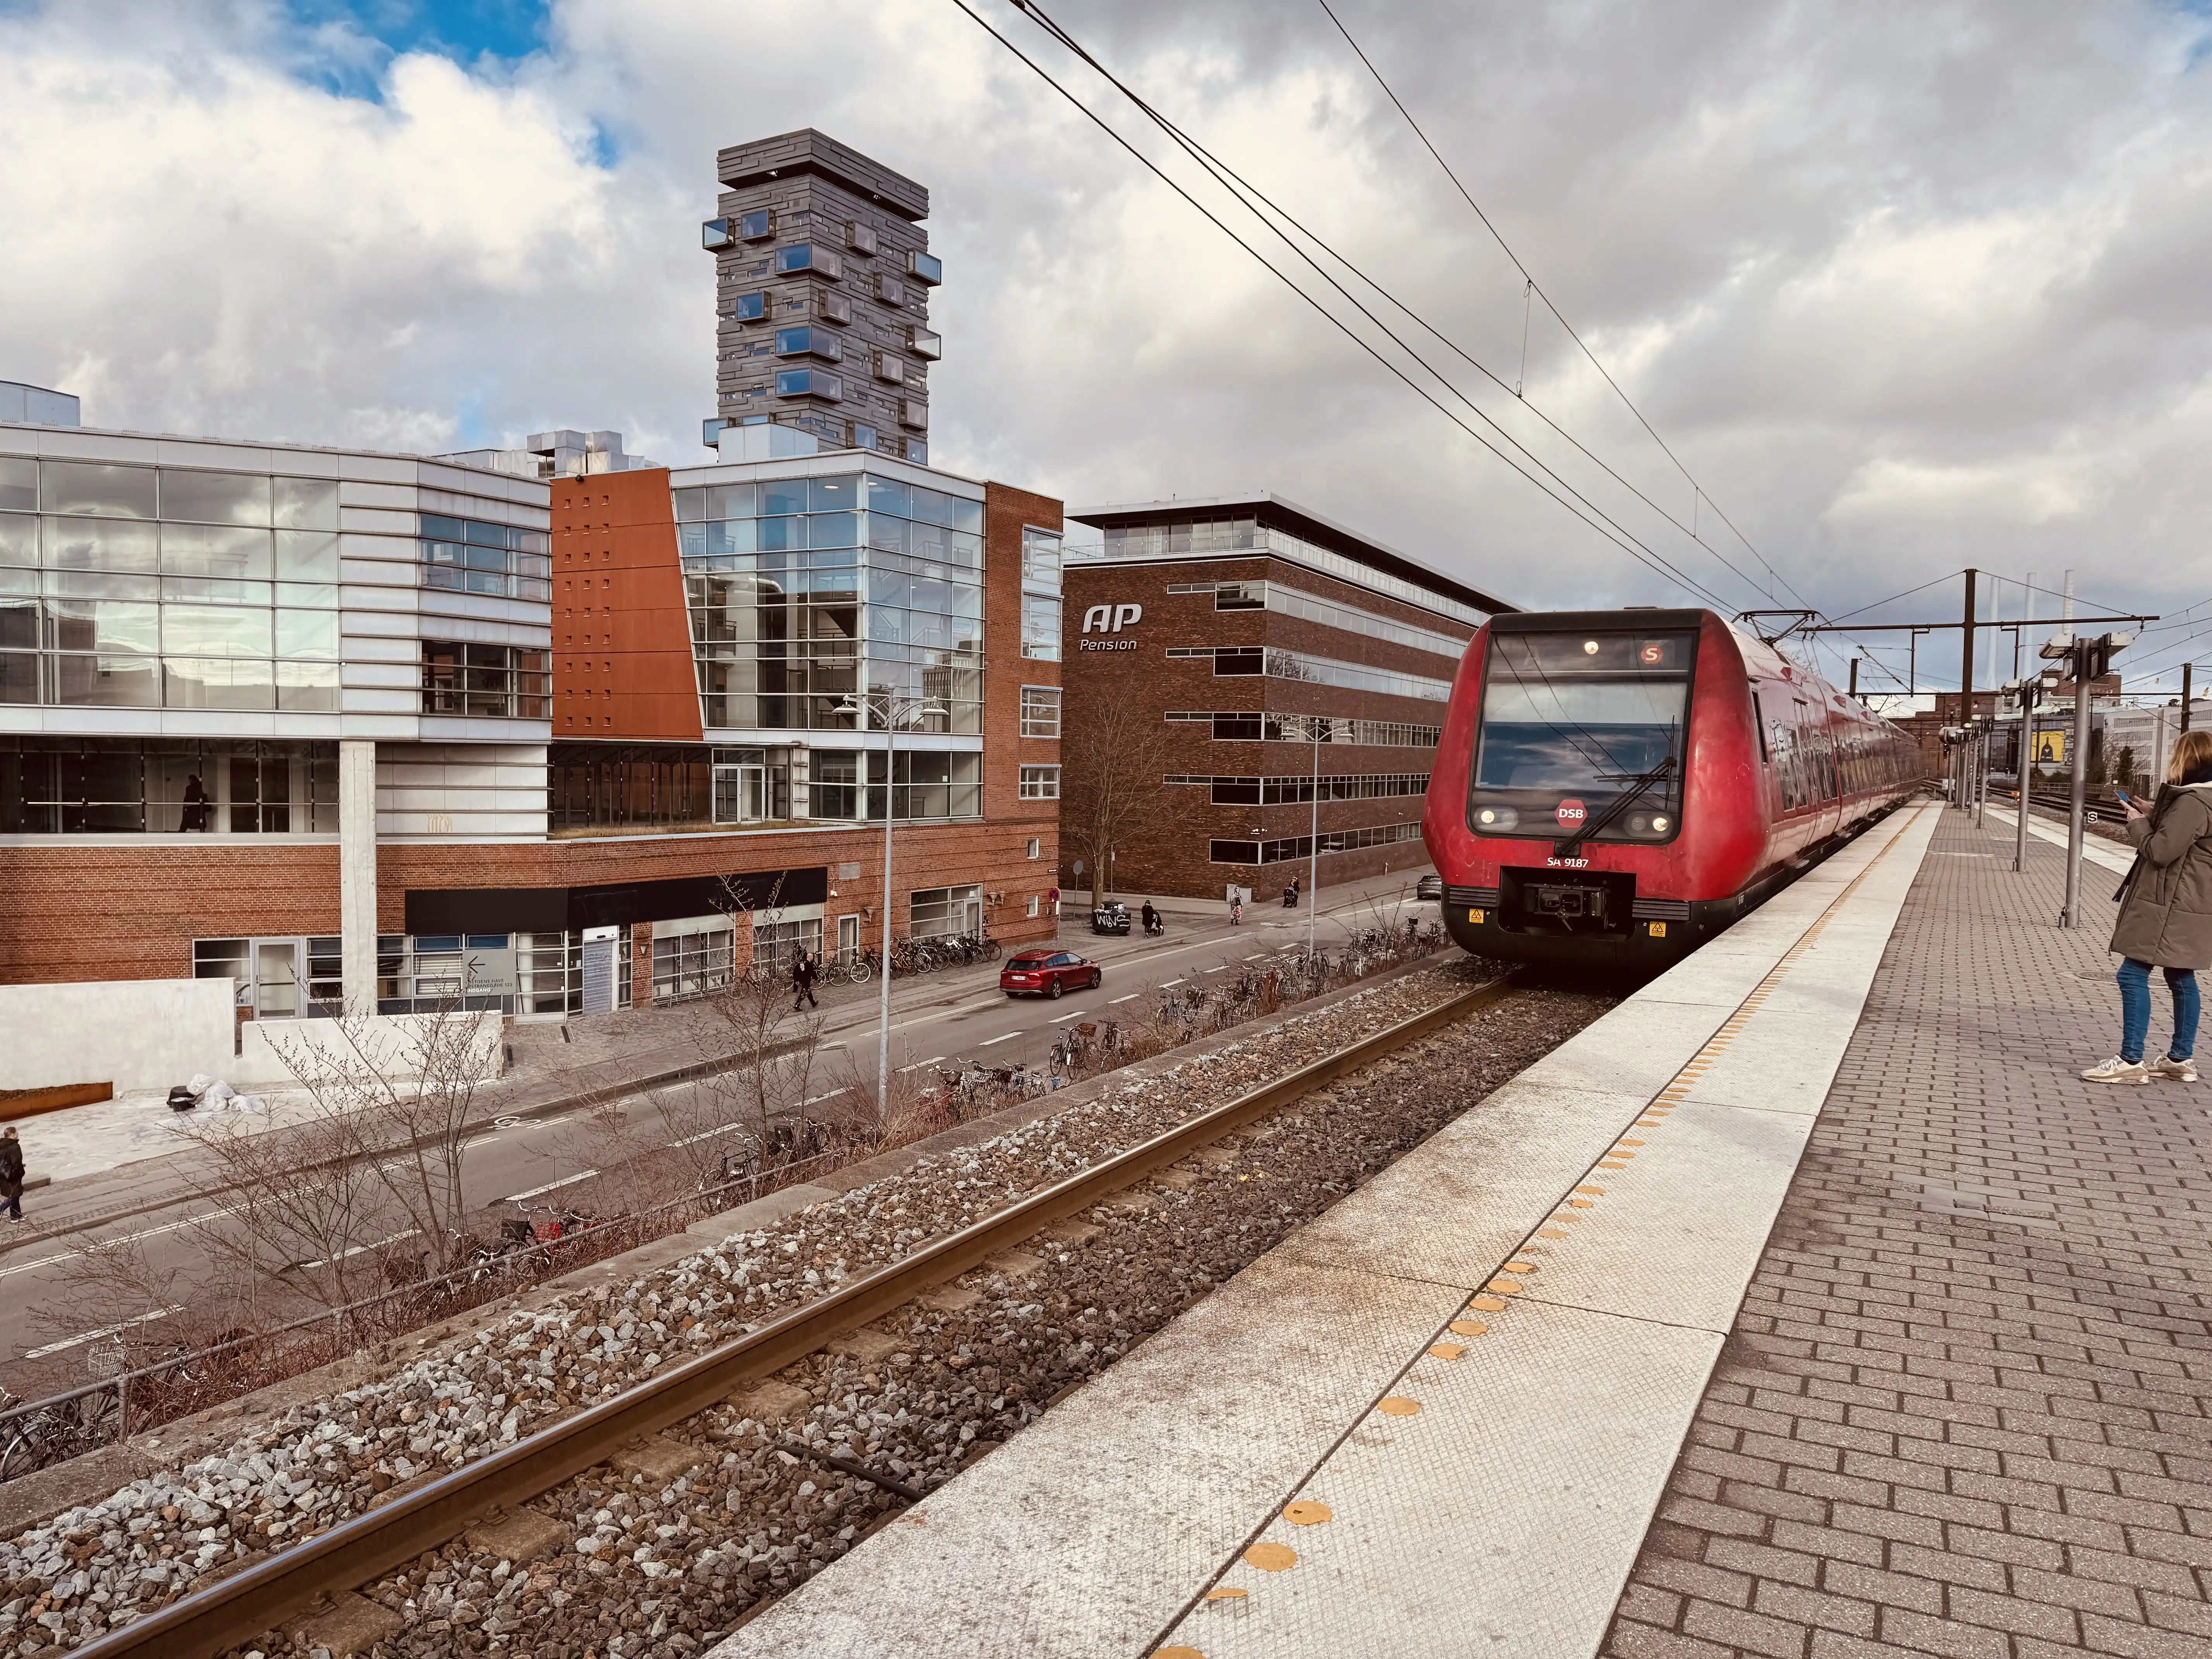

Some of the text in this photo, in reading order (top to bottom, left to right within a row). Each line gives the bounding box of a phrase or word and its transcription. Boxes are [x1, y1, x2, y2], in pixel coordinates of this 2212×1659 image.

[1082, 604, 1142, 633] AP
[1080, 639, 1137, 651] Pension
[1645, 648, 1657, 661] S
[1559, 809, 1583, 818] DSB
[2089, 814, 2097, 822] S
[1547, 857, 1589, 868] SA 9187
